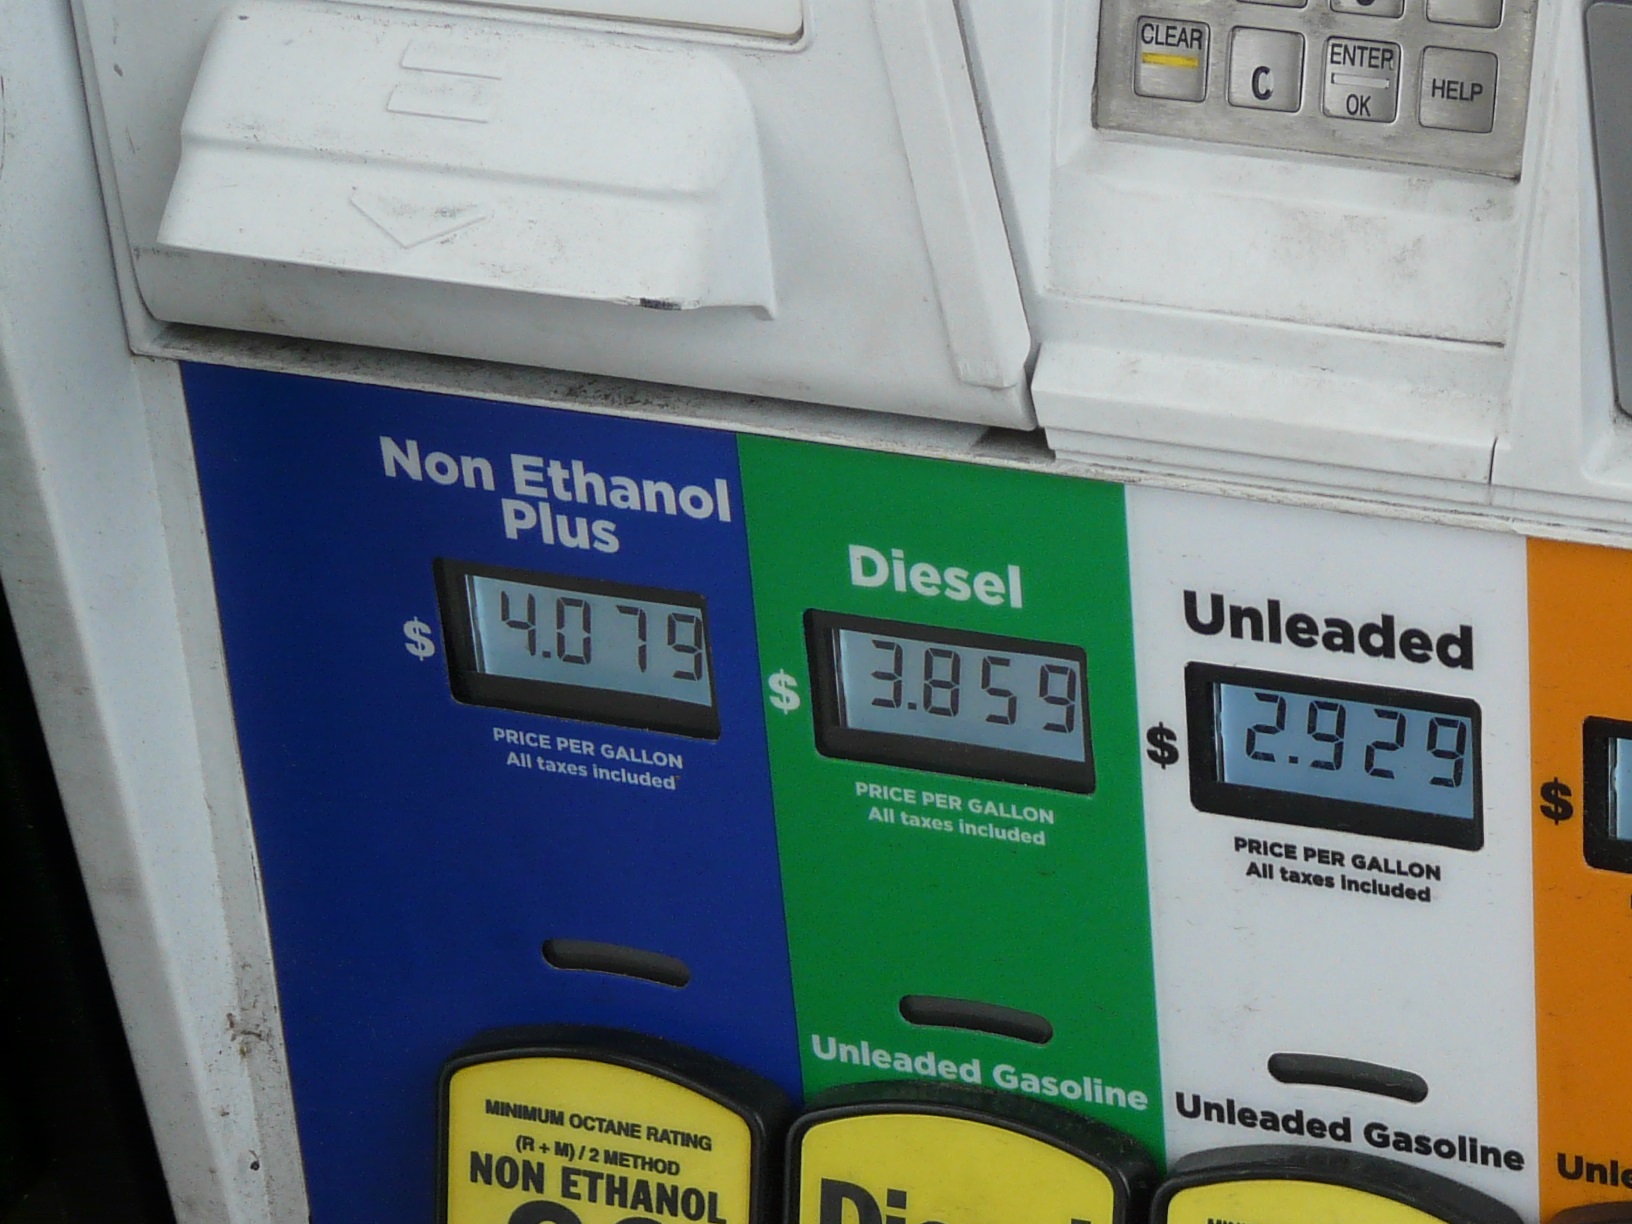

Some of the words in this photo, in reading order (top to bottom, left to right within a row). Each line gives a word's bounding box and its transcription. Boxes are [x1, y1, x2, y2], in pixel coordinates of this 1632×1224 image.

[1141, 23, 1203, 50] CLEAR
[1330, 43, 1394, 71] ENTER
[1251, 65, 1272, 100] C
[1346, 92, 1372, 117] OK
[1431, 78, 1483, 102] HELP
[379, 435, 496, 492] Non
[510, 453, 732, 523] Ethanol
[501, 497, 620, 554] Plus
[848, 544, 1023, 609] Diesel
[403, 616, 436, 662] $
[501, 590, 704, 683] 4.079
[1183, 589, 1474, 671] Unleaded
[768, 669, 801, 715] $
[871, 639, 1077, 734] 3.859
[492, 727, 551, 750] PRICE
[556, 737, 595, 757] PER
[601, 743, 684, 770] GALLON
[1146, 721, 1180, 770] $
[1246, 691, 1467, 788] 2.929
[506, 752, 532, 769] All
[537, 755, 588, 778] taxes
[592, 764, 677, 791] included
[855, 781, 917, 804] PRICE
[922, 791, 962, 811] PER
[968, 798, 1055, 825] GALLON
[1539, 777, 1573, 825] $
[868, 805, 895, 824] All
[900, 811, 954, 833] taxes
[959, 820, 1047, 847] included
[1234, 836, 1298, 860] PRICE
[1303, 846, 1345, 867] PER
[1352, 853, 1441, 881] GALLON
[1246, 860, 1274, 880] All
[1279, 866, 1335, 889] taxes
[1341, 874, 1431, 903] included
[812, 1034, 981, 1085] Unleaded
[993, 1063, 1148, 1111] Gasoline
[485, 1099, 565, 1127] MINIMUM
[569, 1113, 642, 1140] OCTANE
[646, 1124, 713, 1152] RATING
[1175, 1091, 1352, 1143] Unleaded
[1364, 1122, 1525, 1172] Gasoline
[470, 1151, 545, 1195] NON
[590, 1147, 600, 1163] 2
[604, 1149, 681, 1177] METHOD
